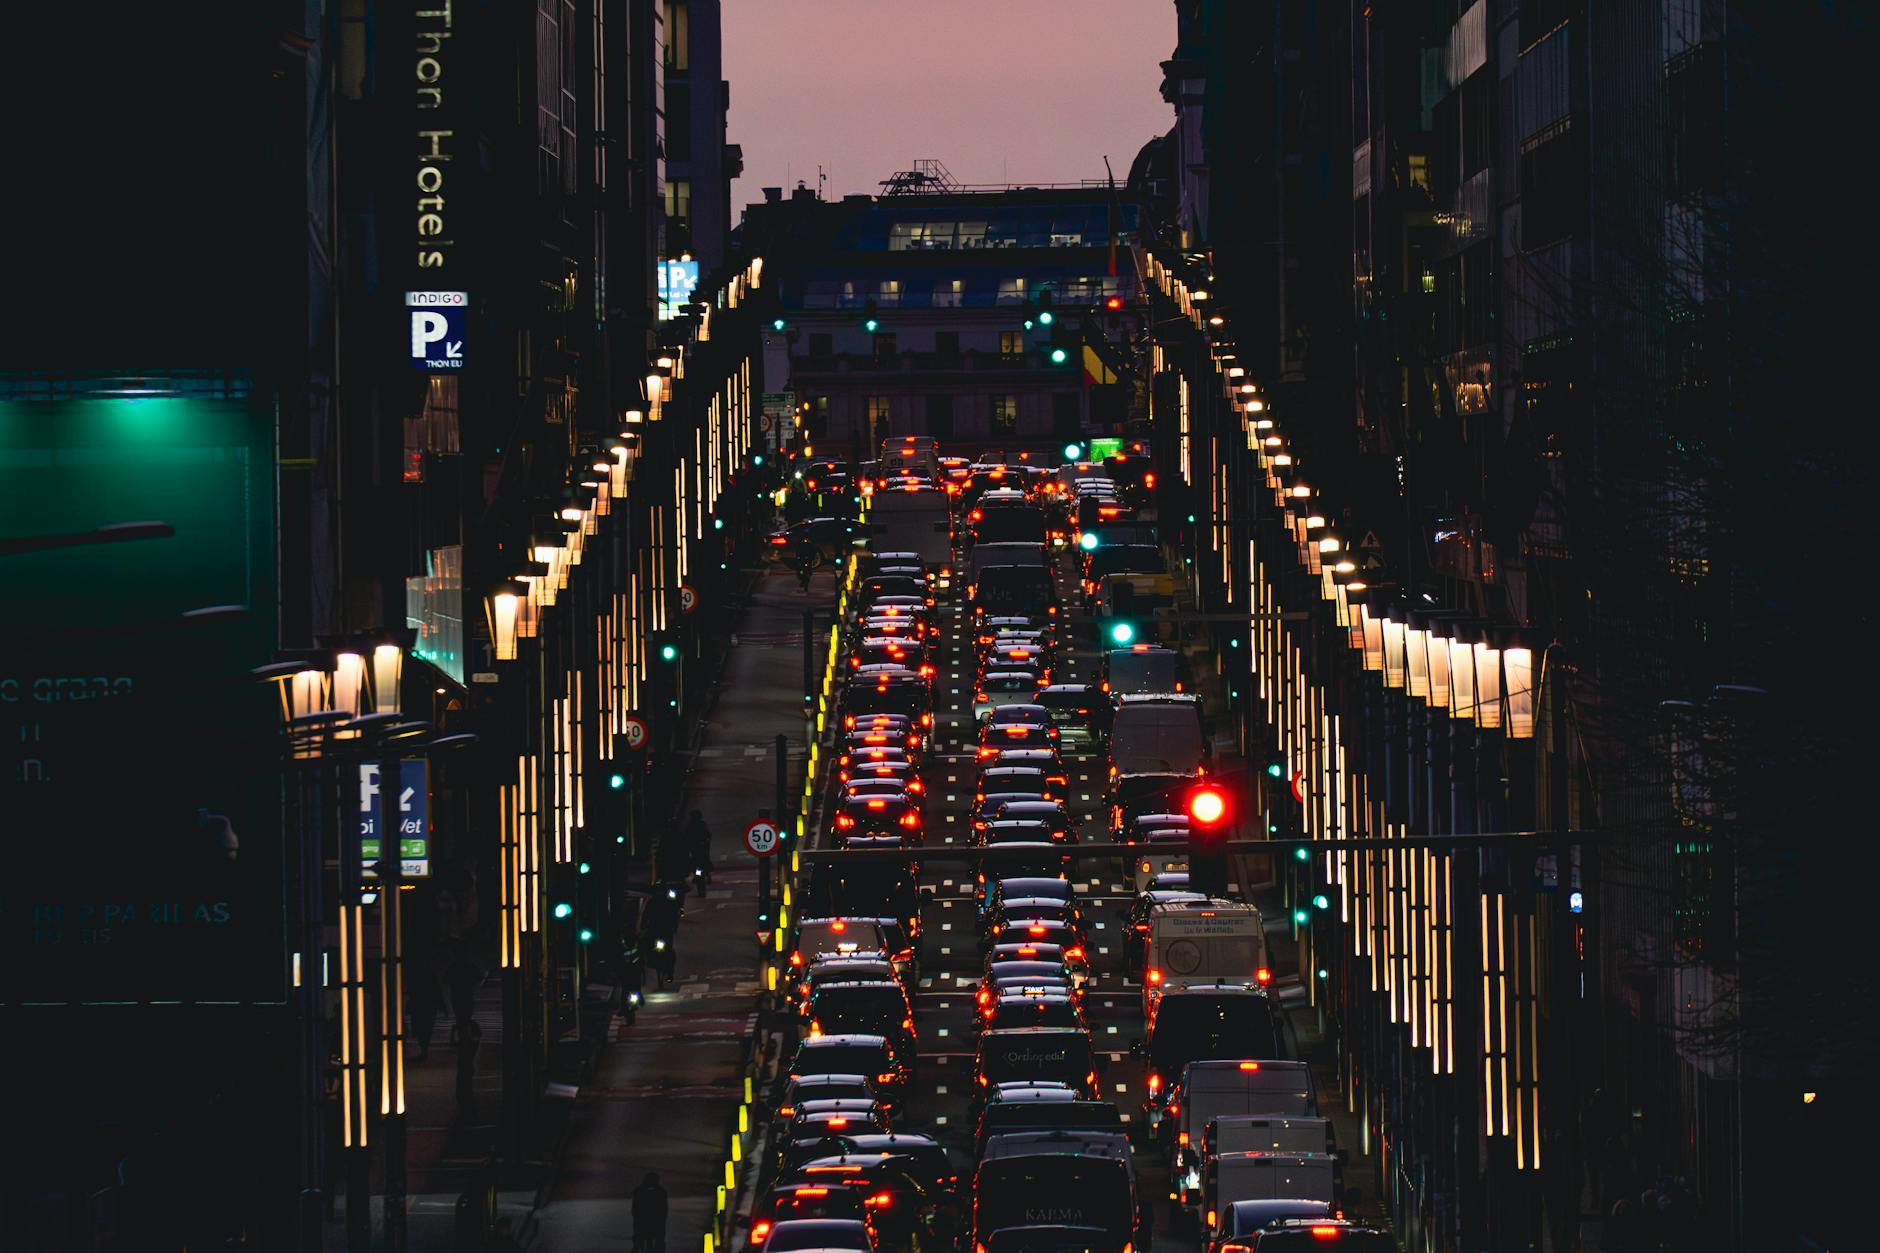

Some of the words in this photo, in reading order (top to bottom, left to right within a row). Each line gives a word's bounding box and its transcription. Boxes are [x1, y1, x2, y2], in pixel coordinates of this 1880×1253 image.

[416, 0, 452, 109] Thon
[416, 129, 454, 269] Hotels
[413, 294, 462, 304] INDIGO
[411, 311, 449, 358] P
[425, 360, 449, 369] THON
[752, 829, 772, 843] 50
[1025, 1208, 1084, 1221] KARMA
